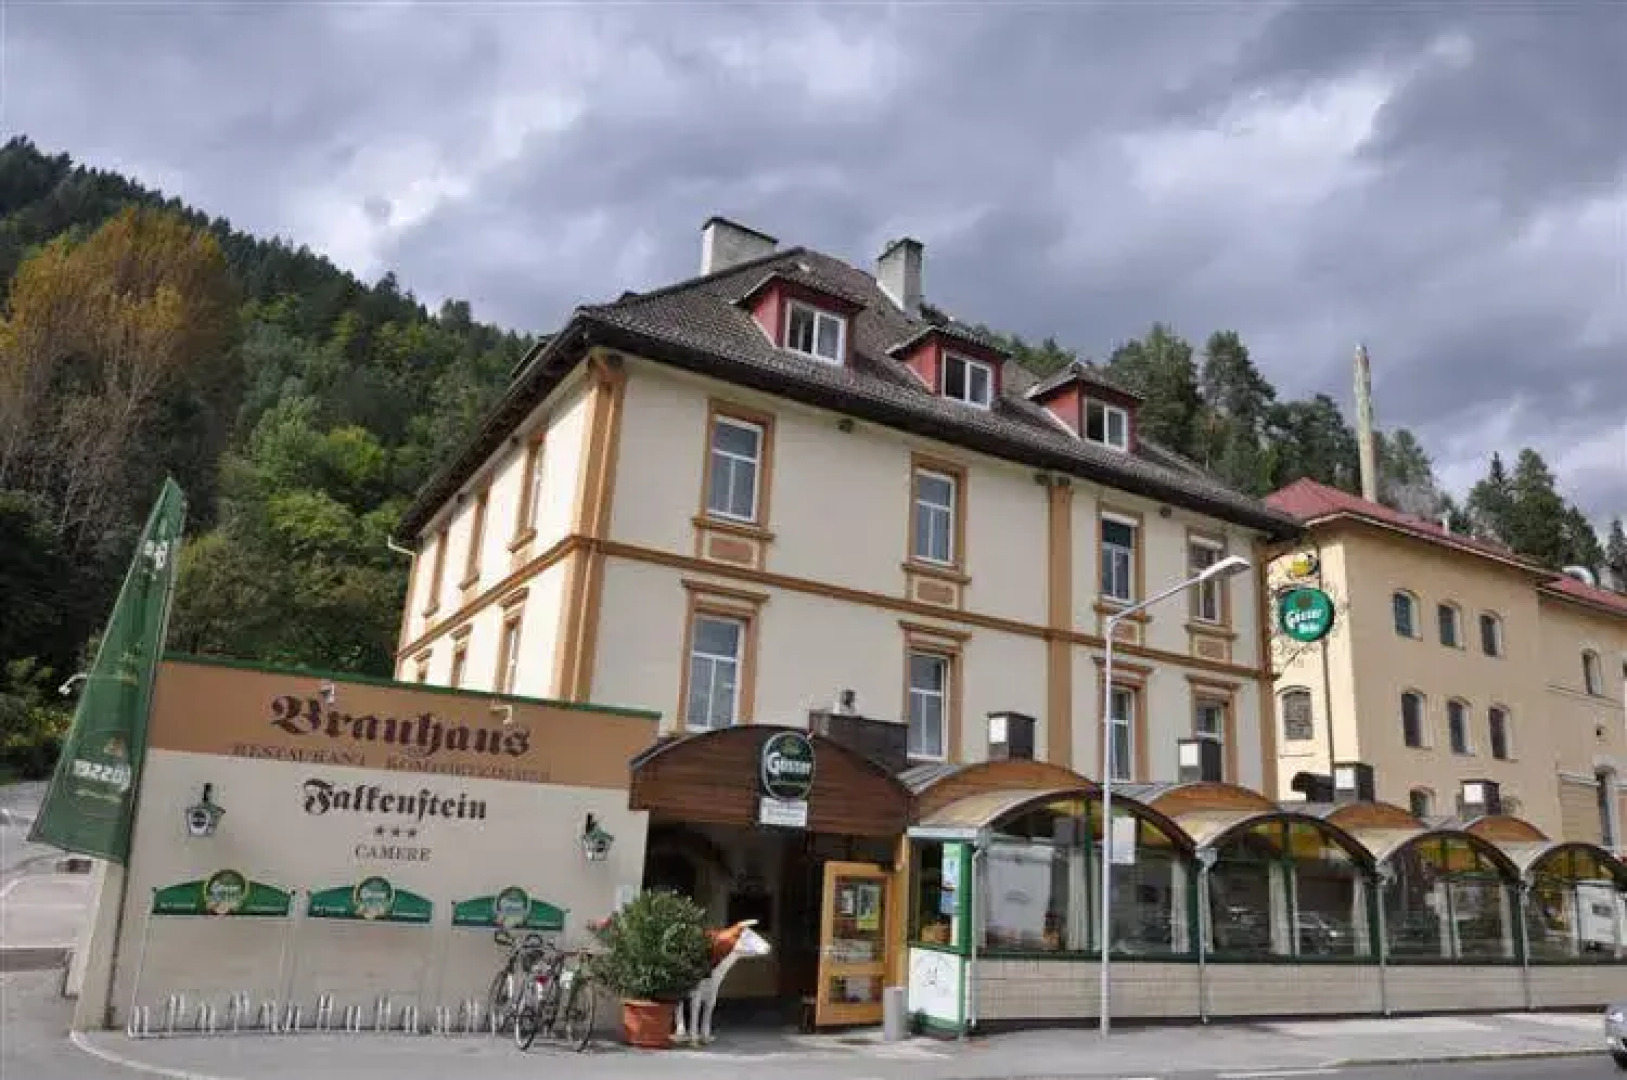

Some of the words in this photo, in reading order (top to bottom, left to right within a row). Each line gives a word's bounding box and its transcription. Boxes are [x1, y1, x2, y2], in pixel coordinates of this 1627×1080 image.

[270, 695, 531, 757] Brauhaus
[303, 778, 487, 822] Falkenstein
[355, 844, 432, 862] CAMERE
